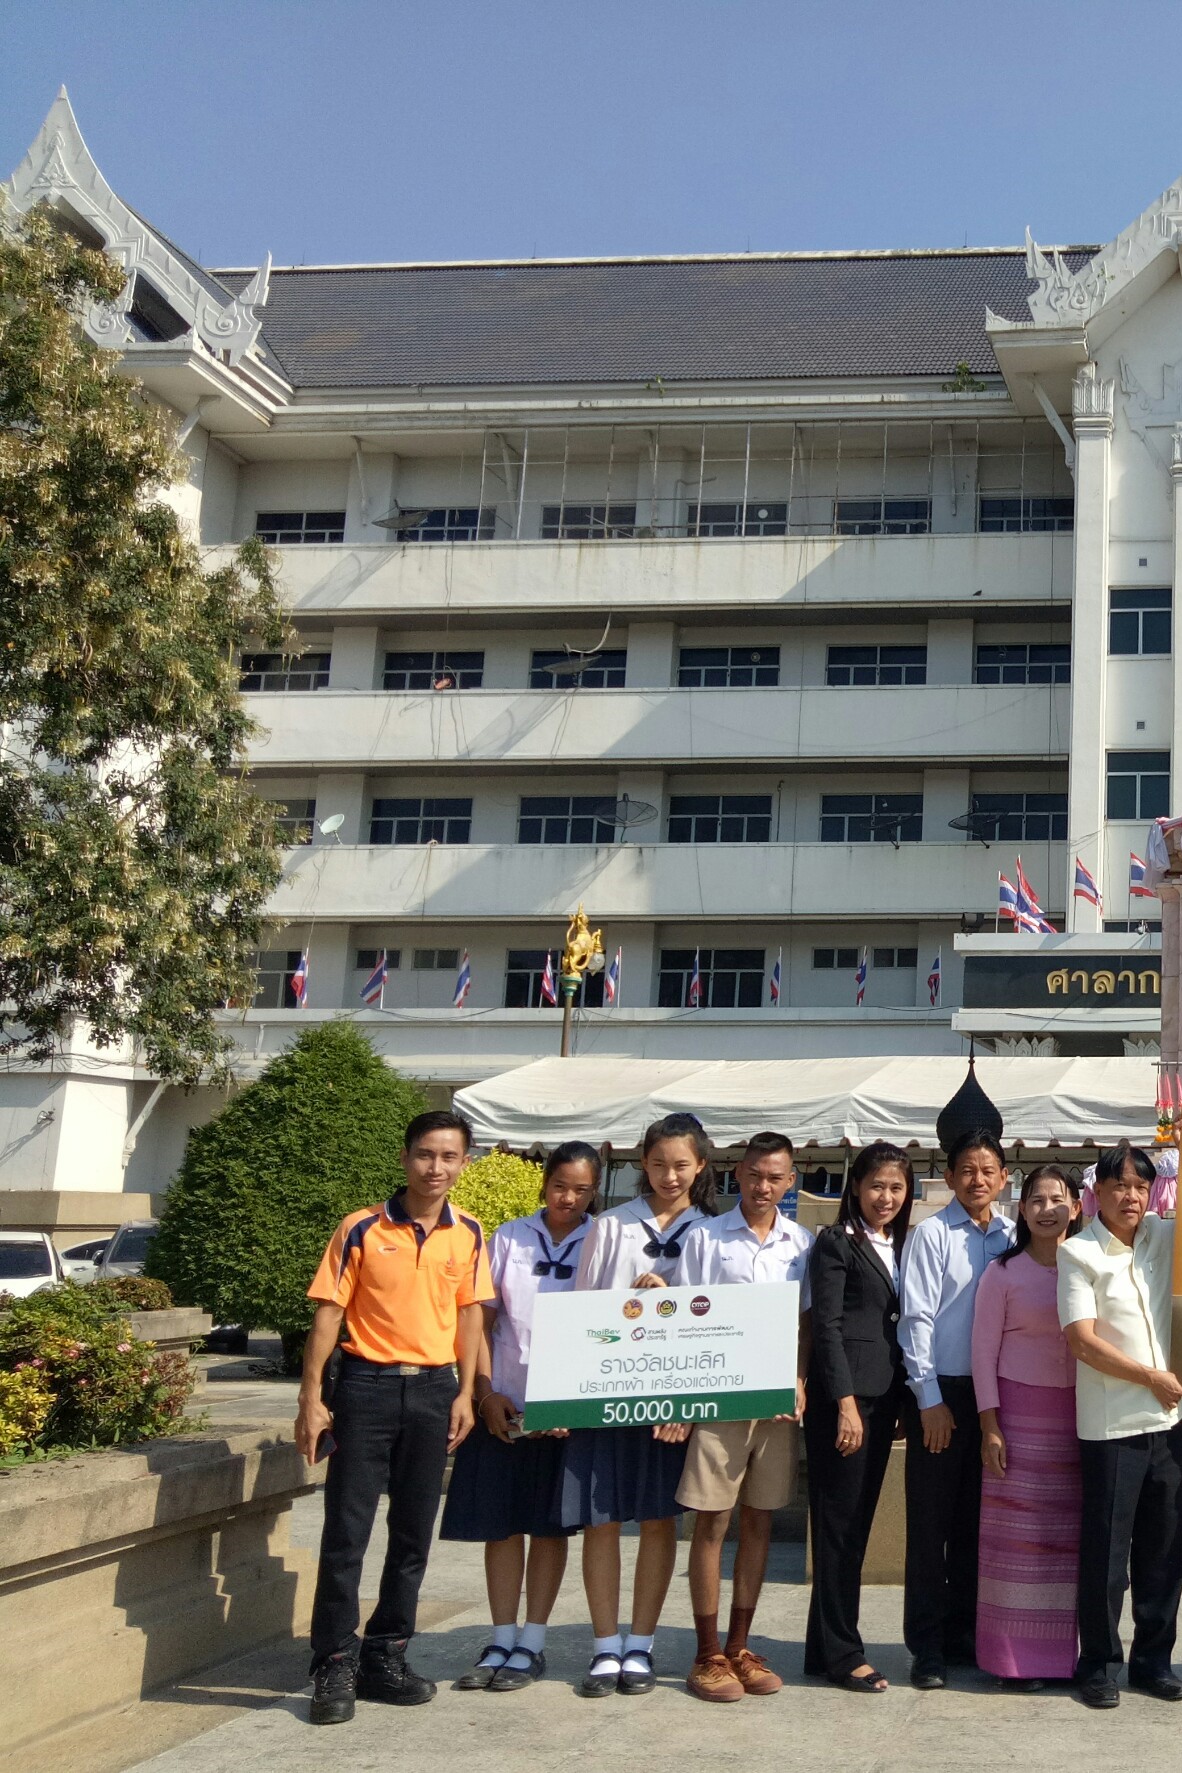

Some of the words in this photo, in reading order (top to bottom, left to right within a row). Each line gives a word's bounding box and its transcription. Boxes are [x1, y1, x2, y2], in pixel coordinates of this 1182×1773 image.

[1046, 967, 1160, 994] ศาลาก
[586, 1328, 621, 1337] ThaiBev
[600, 1350, 726, 1374] รางวัลชนะเลิศ
[579, 1376, 644, 1394] ประเภทผ้า
[651, 1372, 744, 1391] เครื่องแต่งกาย
[602, 1400, 674, 1424] 50,000
[681, 1401, 718, 1419] บาท
